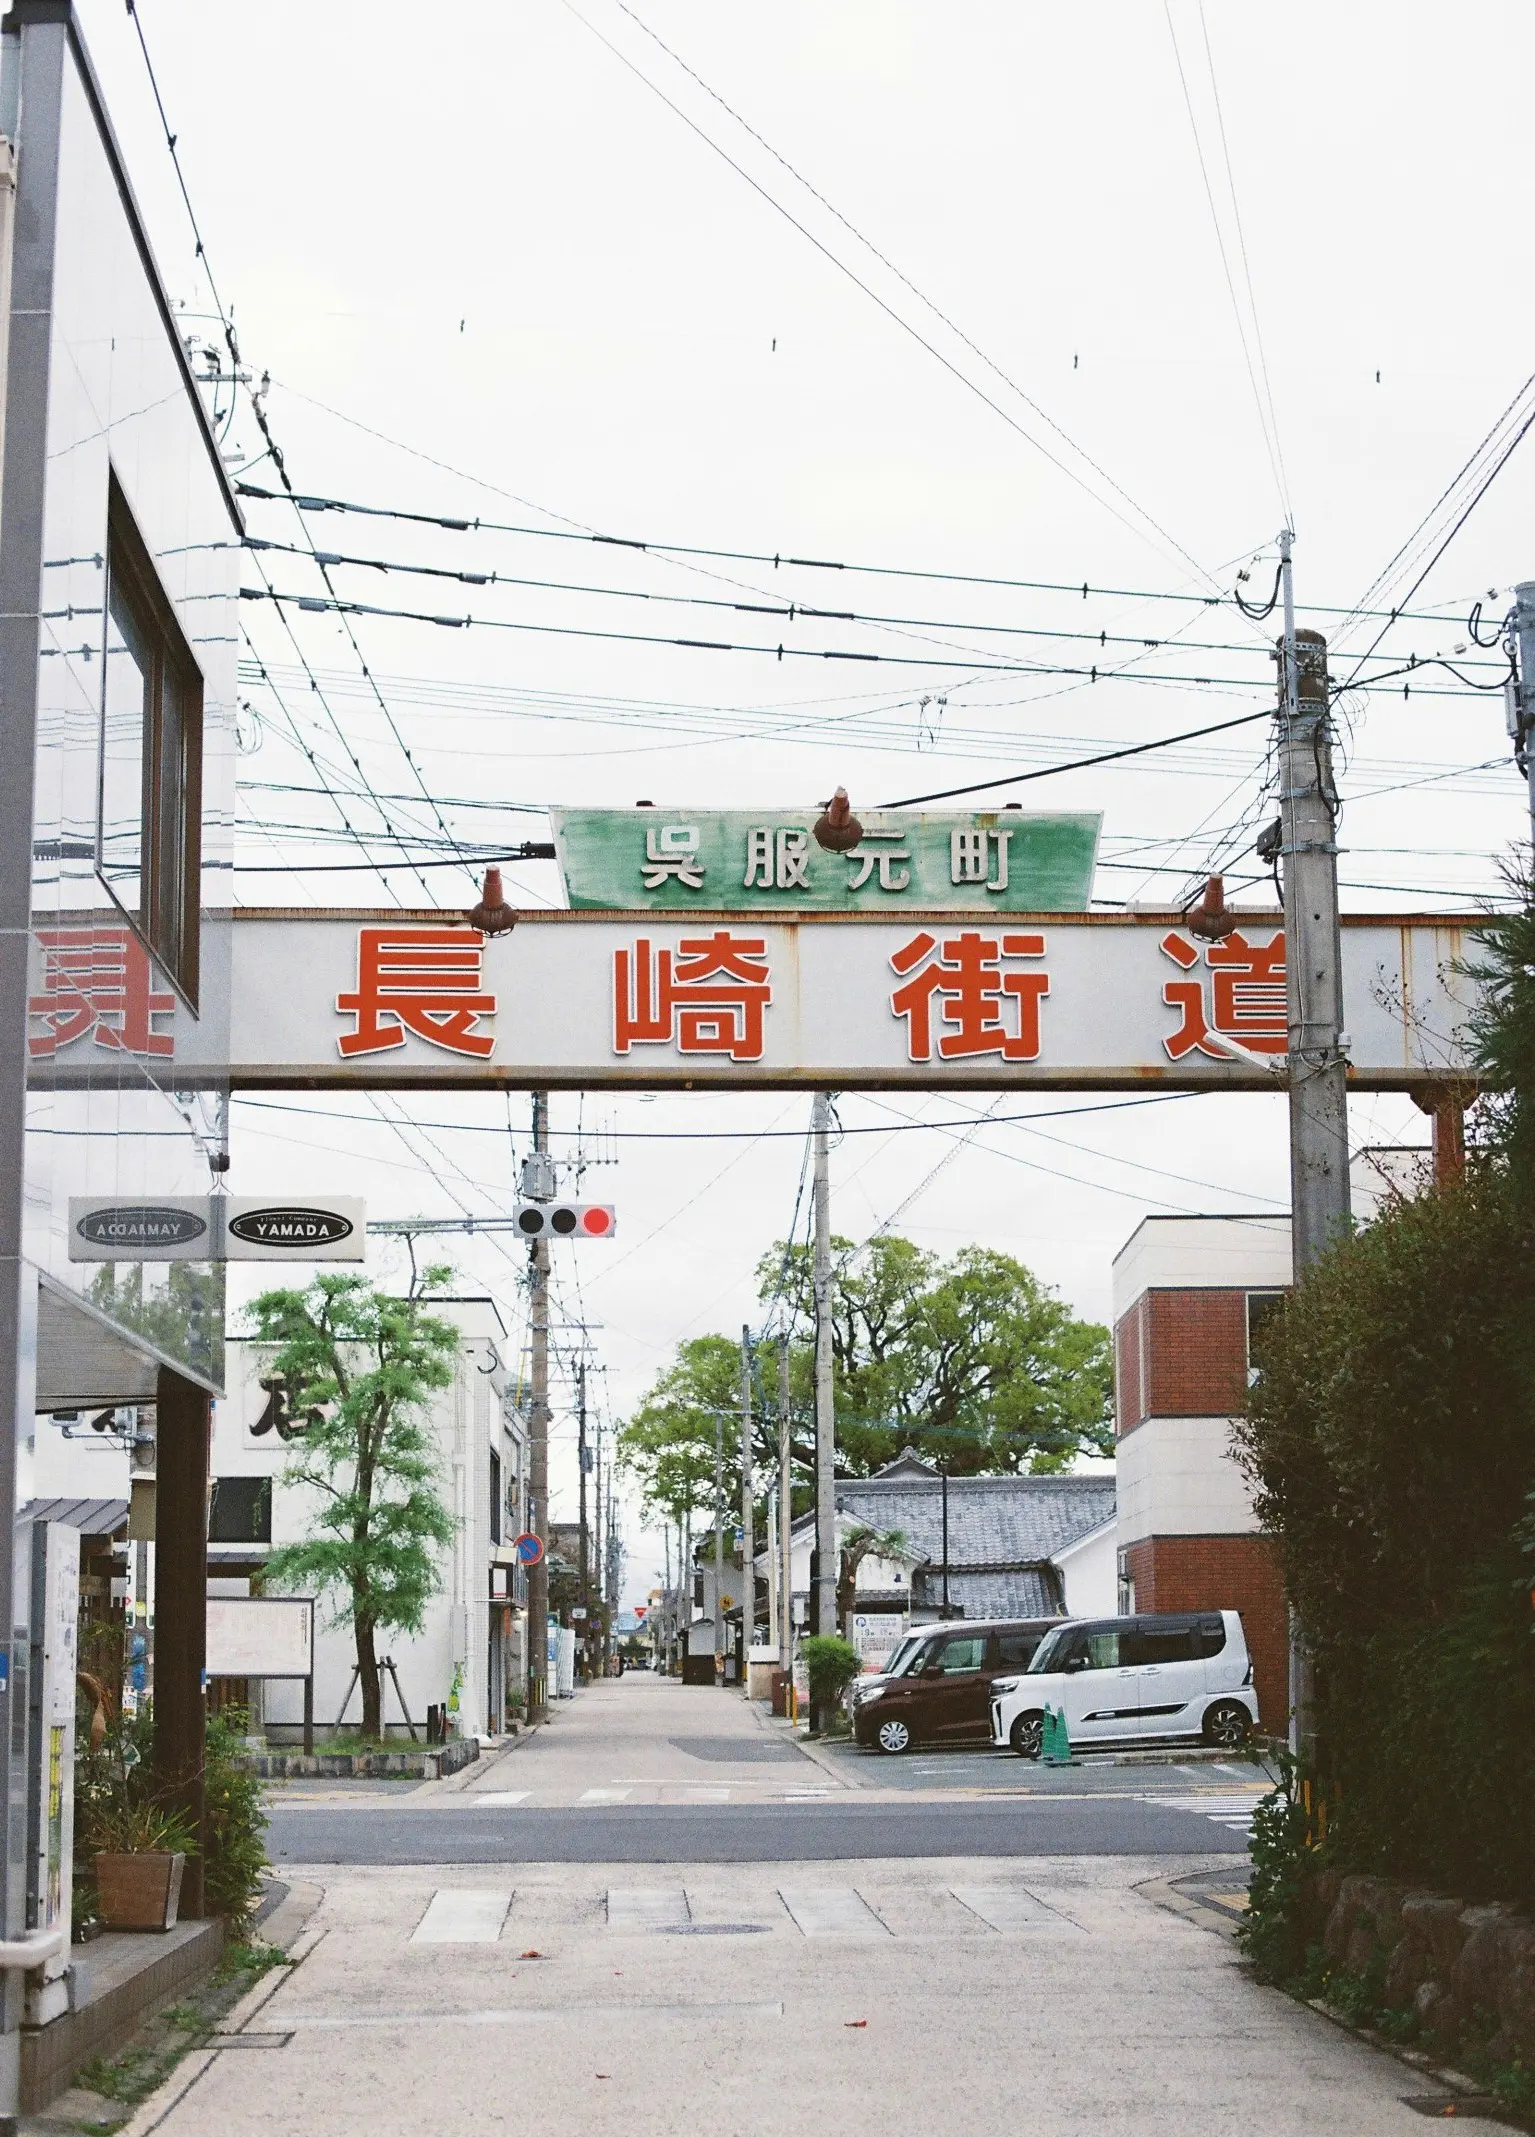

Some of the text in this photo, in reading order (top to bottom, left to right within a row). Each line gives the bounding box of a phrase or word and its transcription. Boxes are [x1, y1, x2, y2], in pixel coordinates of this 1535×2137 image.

[641, 825, 1013, 891] 呉服元町
[335, 927, 1288, 1061] 長崎街道
[256, 1223, 330, 1236] YAMADA
